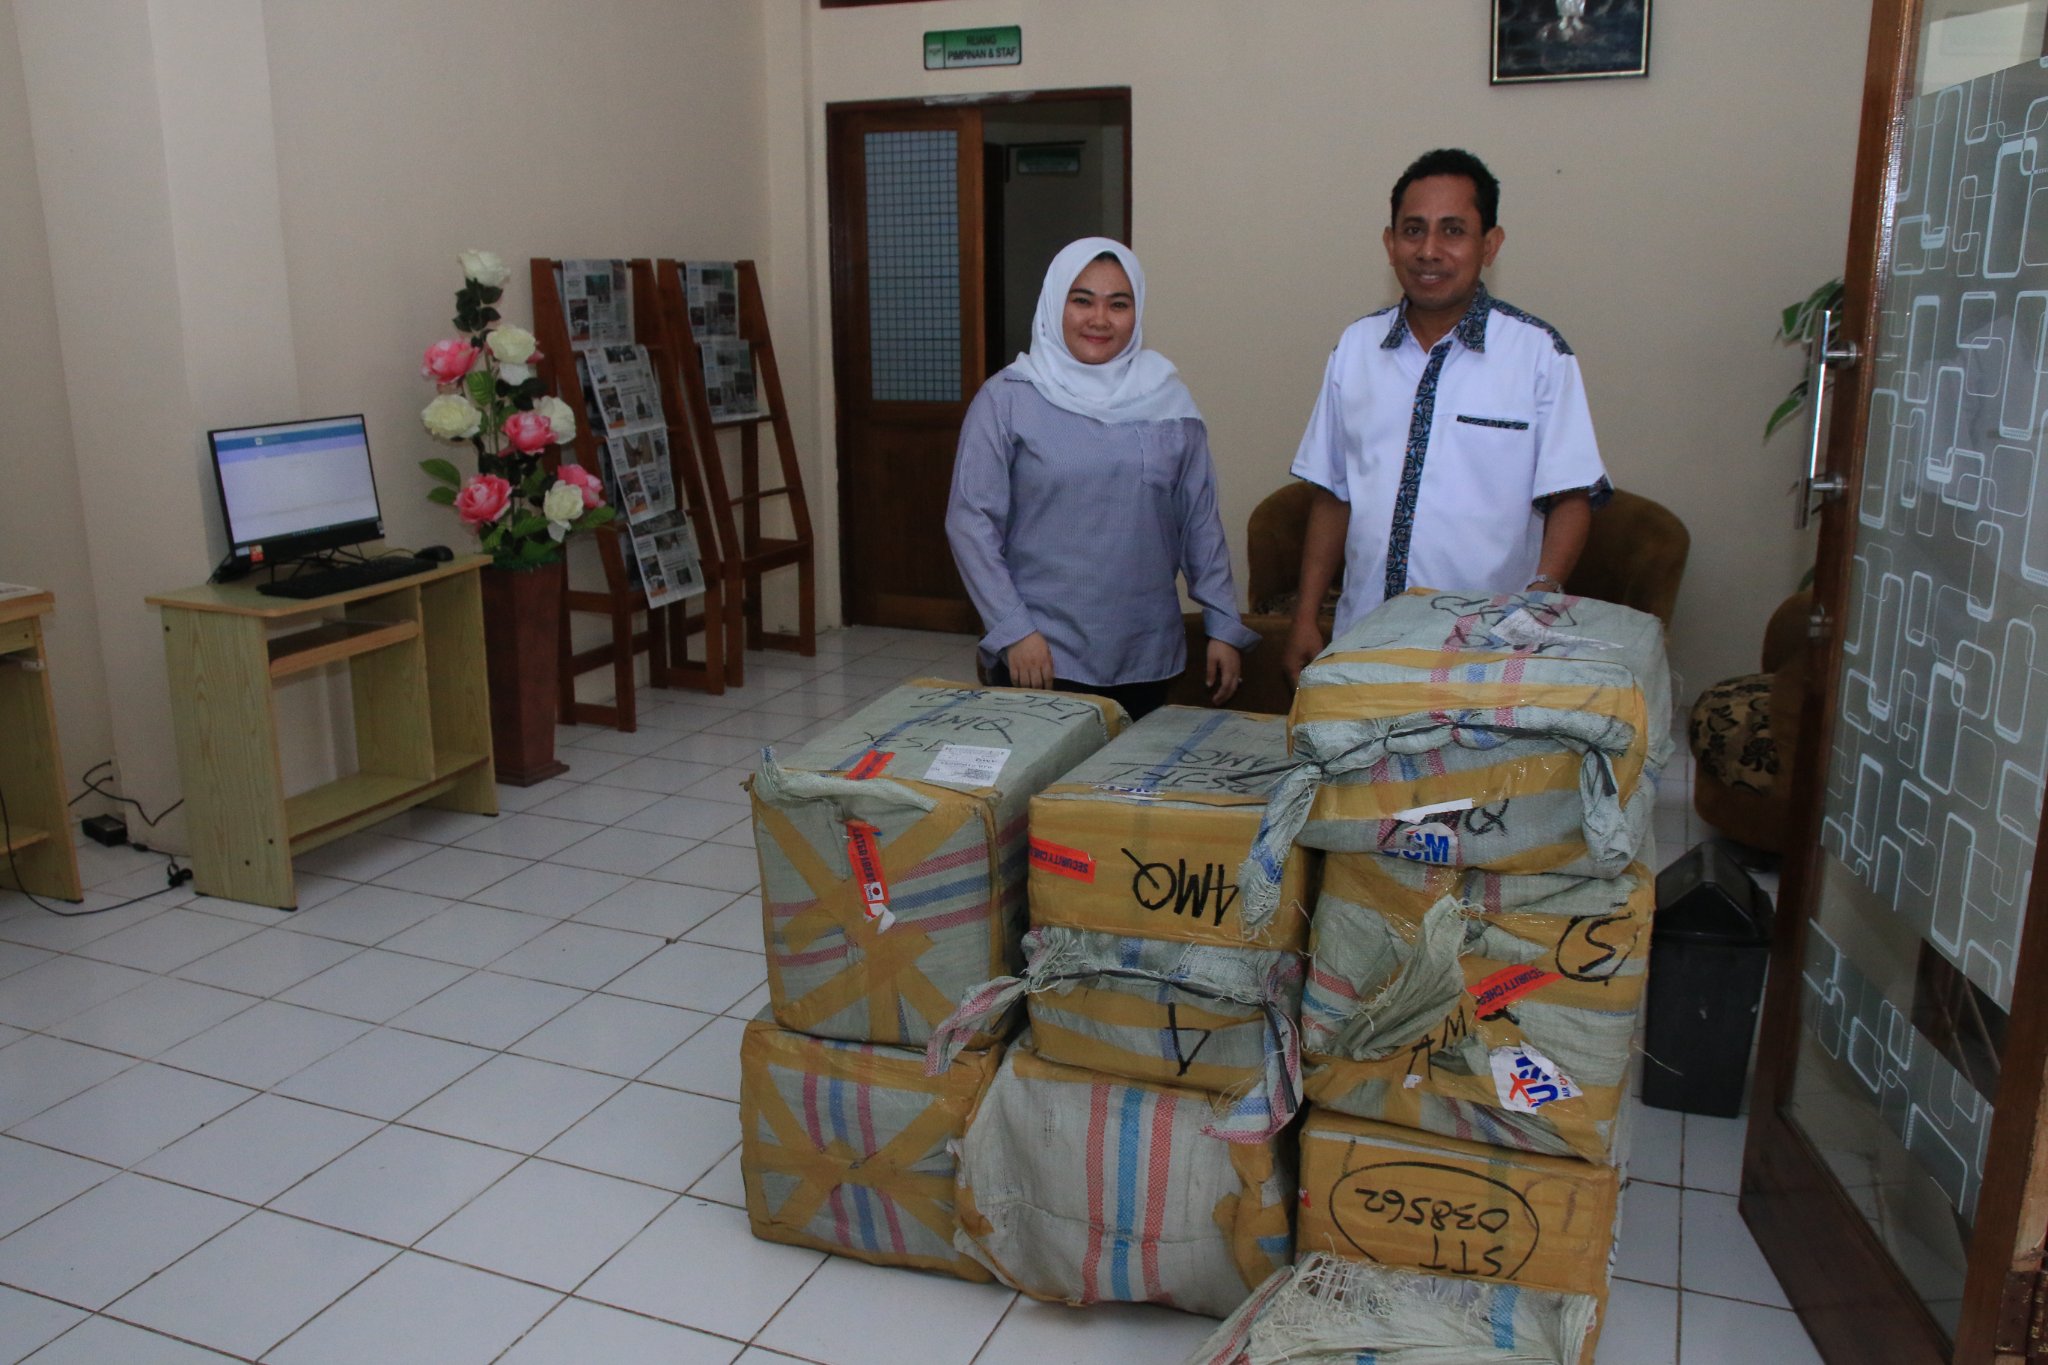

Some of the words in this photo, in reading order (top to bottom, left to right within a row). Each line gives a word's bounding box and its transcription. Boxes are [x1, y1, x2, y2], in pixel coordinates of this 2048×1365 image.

[947, 48, 986, 61] PIMPINAN
[995, 46, 1017, 58] STAF
[1048, 853, 1089, 874] SECURITY
[1561, 1087, 1571, 1098] AIR
[1354, 1188, 1510, 1234] 038562
